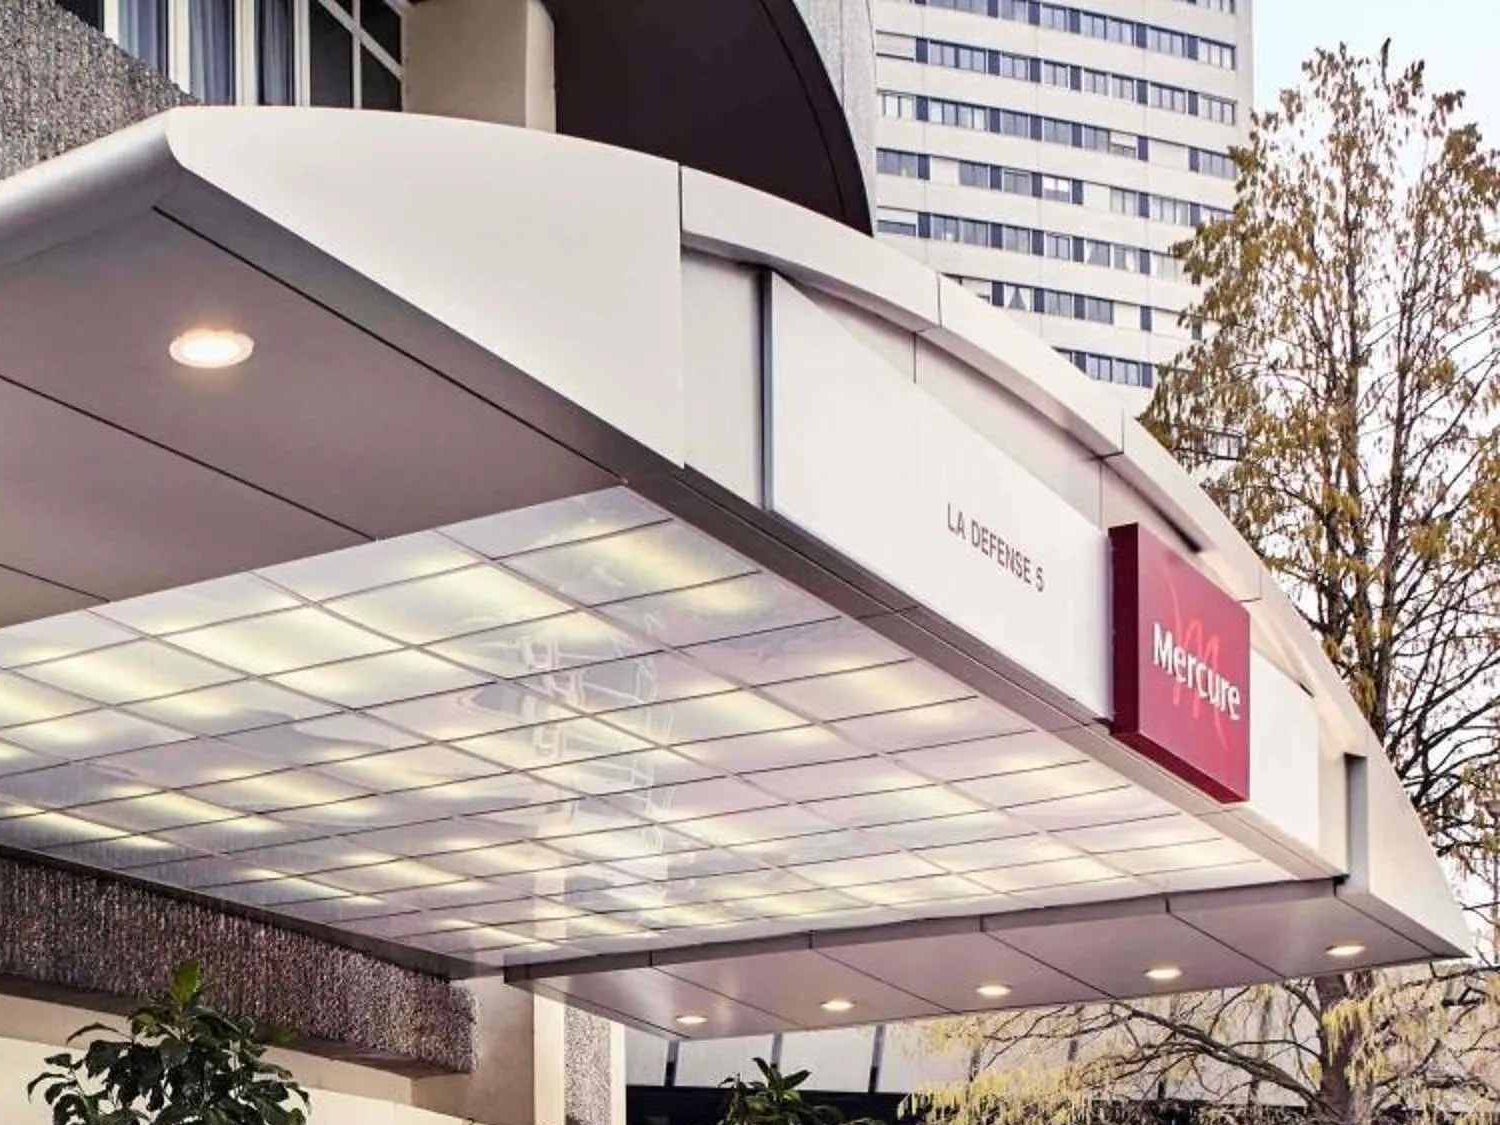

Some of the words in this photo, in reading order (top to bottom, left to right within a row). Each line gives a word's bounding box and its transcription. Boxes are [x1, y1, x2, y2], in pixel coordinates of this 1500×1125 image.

[946, 501, 967, 541] LA
[971, 518, 1032, 585] DEFENSE
[1152, 623, 1242, 721] Mercure
